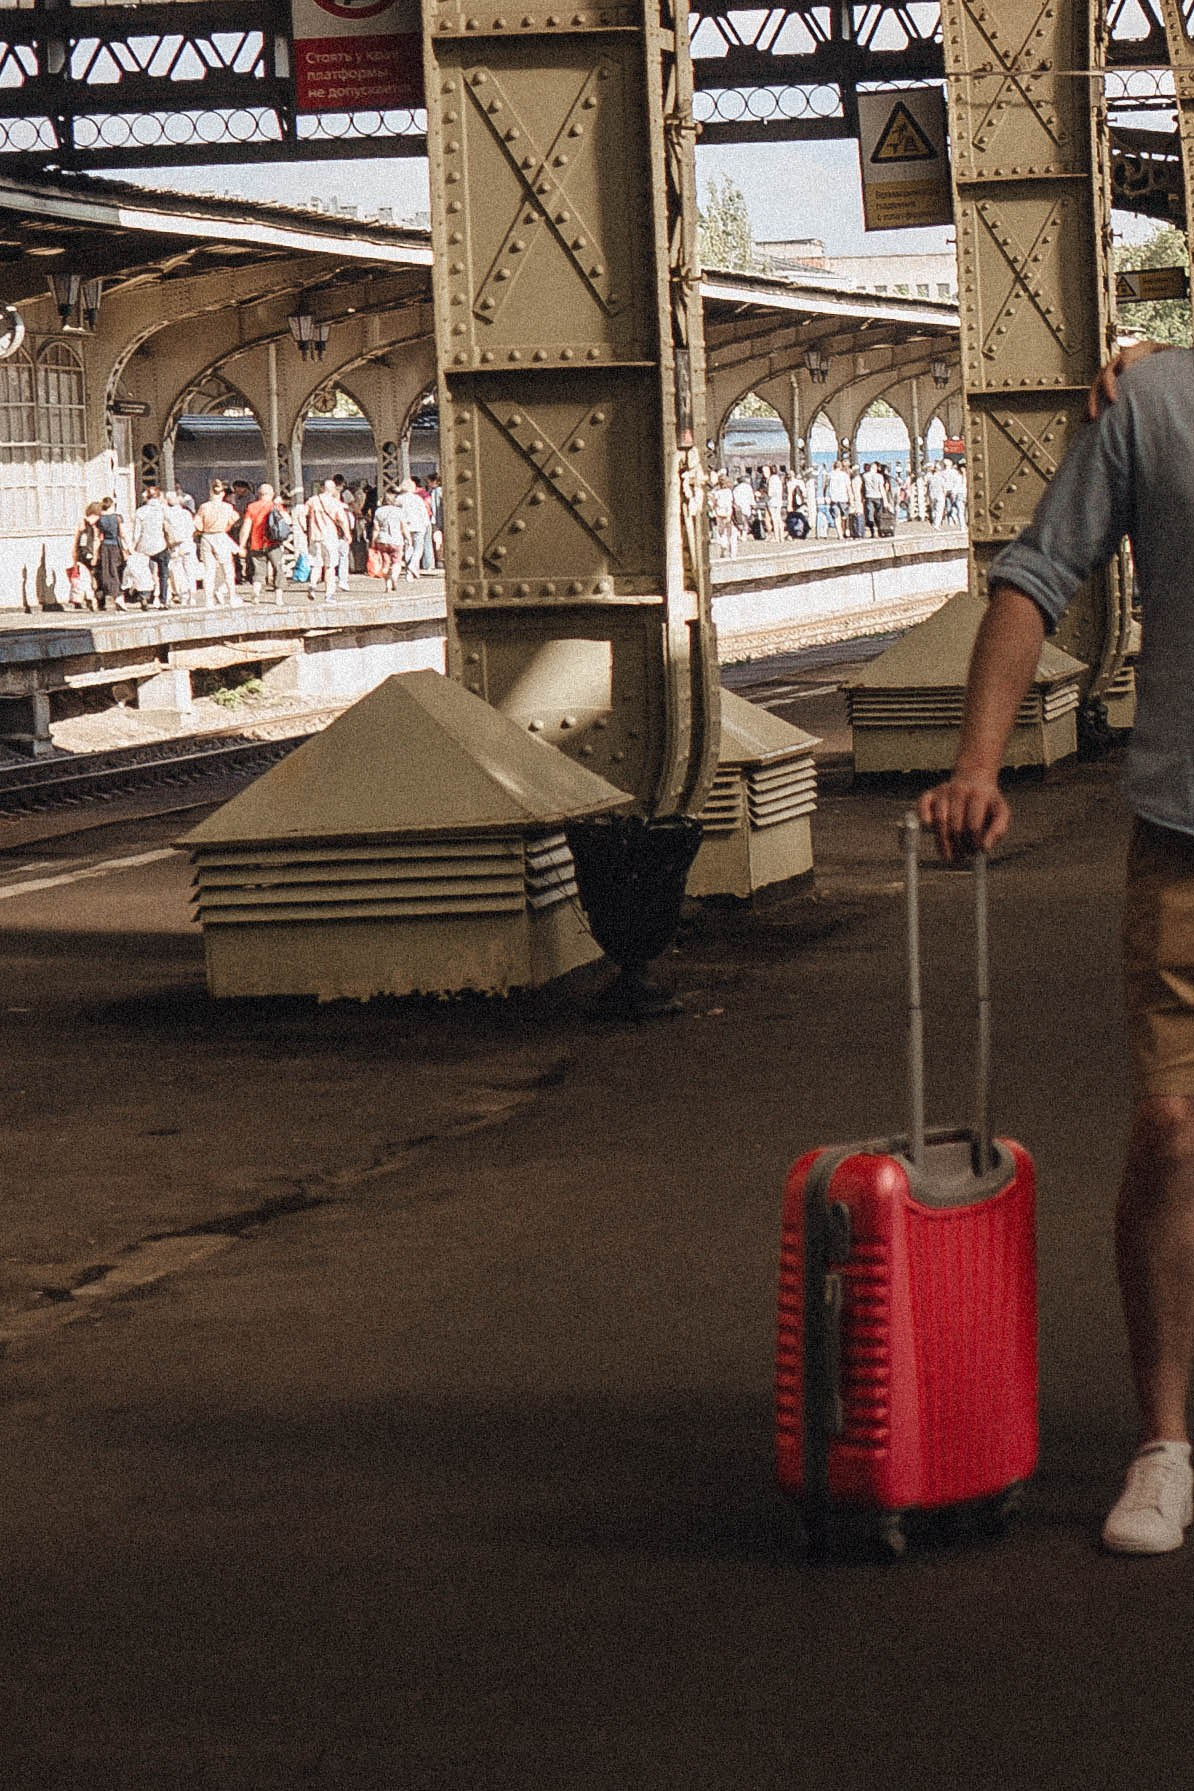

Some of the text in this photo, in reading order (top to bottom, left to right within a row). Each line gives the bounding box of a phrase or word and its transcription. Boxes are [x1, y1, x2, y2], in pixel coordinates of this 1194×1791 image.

[305, 51, 353, 64] Стоять
[354, 52, 363, 64] у
[307, 67, 389, 82] платформы
[308, 88, 326, 98] не
